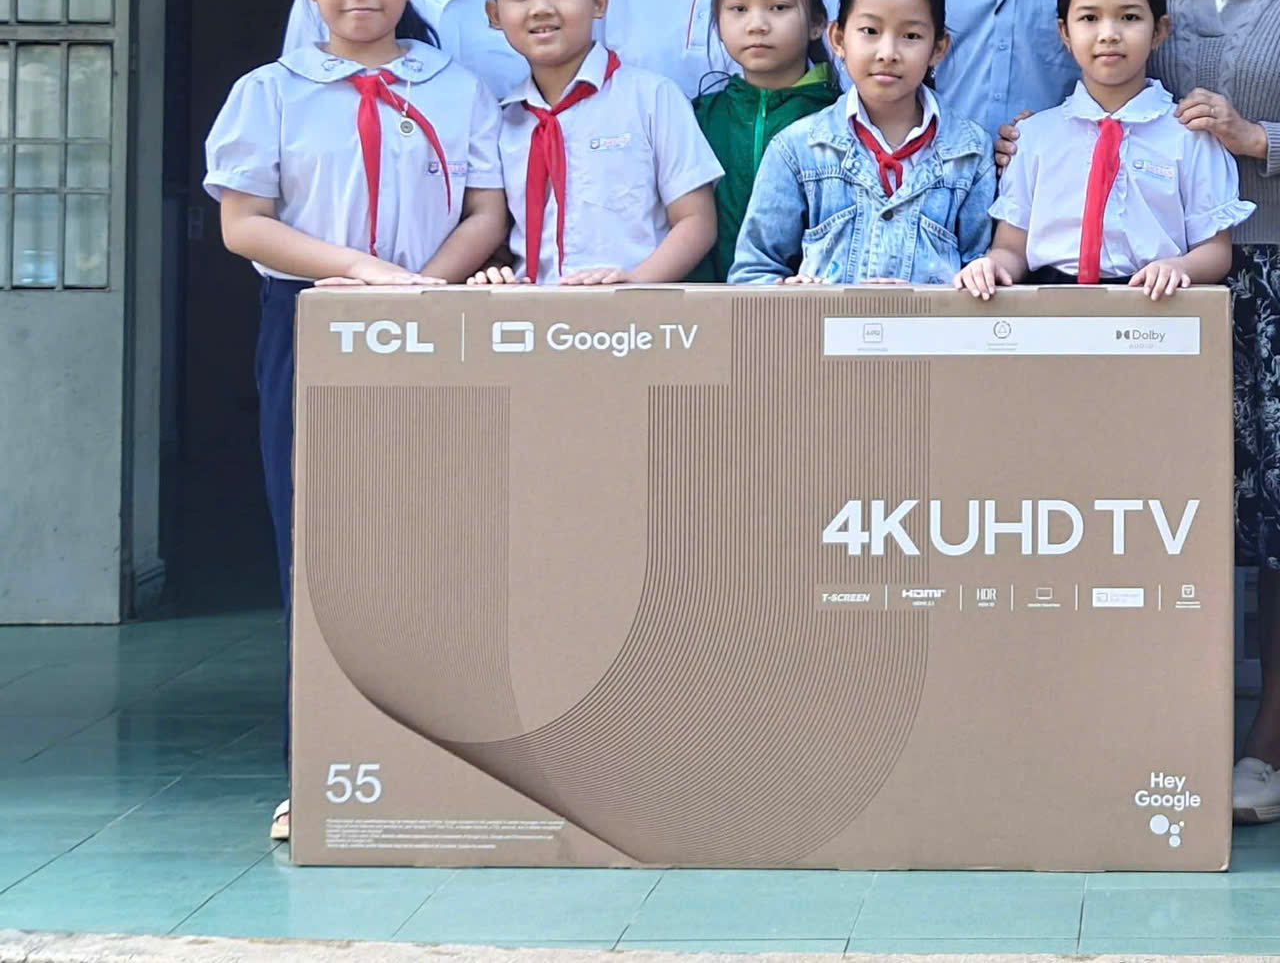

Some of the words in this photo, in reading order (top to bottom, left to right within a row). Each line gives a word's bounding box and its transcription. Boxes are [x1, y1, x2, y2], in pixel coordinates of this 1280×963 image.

[329, 319, 435, 354] TCL
[546, 322, 653, 358] Google
[659, 324, 699, 351] TV
[1132, 329, 1166, 343] Dolby
[821, 499, 921, 556] 4K
[929, 499, 1084, 557] UHD
[1094, 499, 1200, 556] TV
[821, 593, 871, 603] T-SCREEN
[325, 763, 383, 805] 55
[1150, 771, 1187, 793] Hey
[1134, 789, 1202, 812] Google
